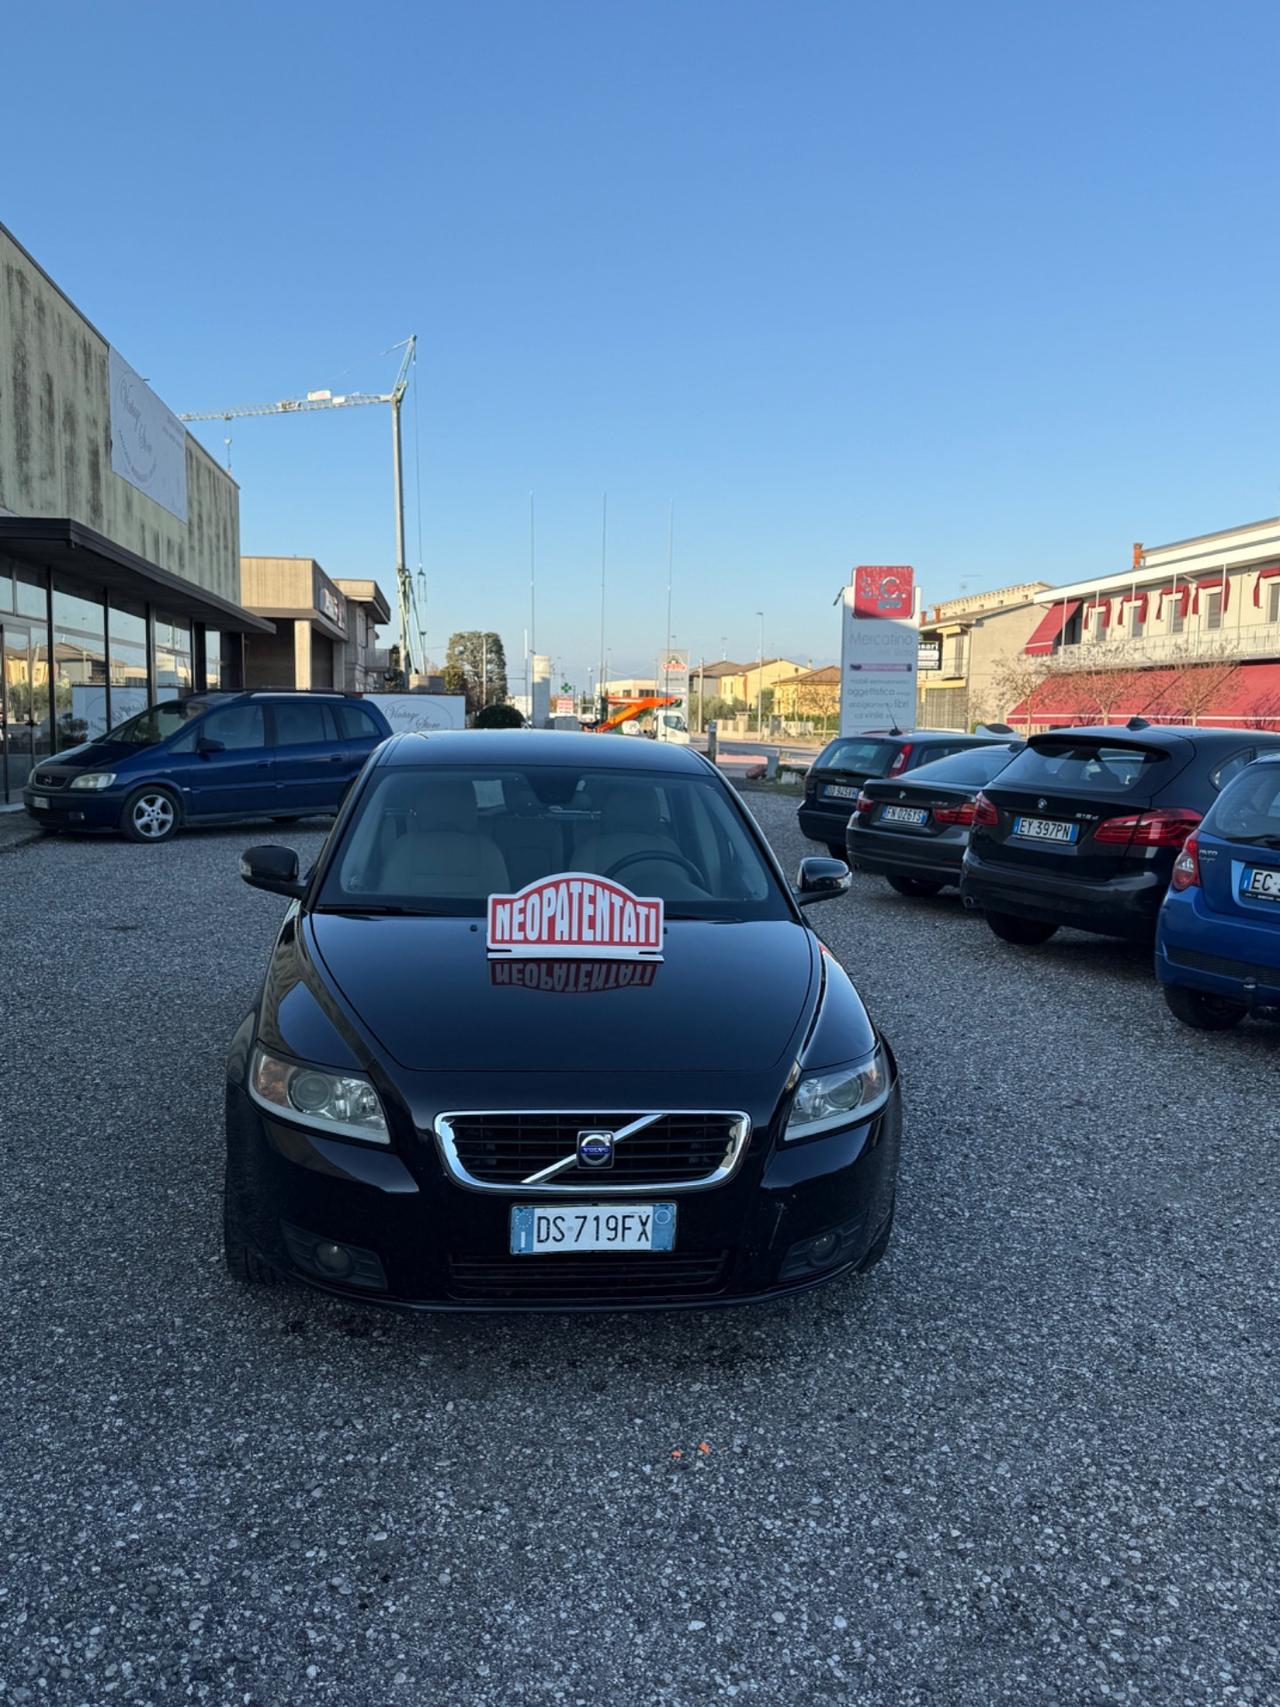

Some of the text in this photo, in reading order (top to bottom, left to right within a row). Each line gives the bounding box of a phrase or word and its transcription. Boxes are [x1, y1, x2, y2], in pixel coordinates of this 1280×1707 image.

[850, 632, 913, 646] Mercatino
[1019, 820, 1034, 833] EY
[1035, 821, 1071, 840] 397PN
[1251, 872, 1273, 891] EC
[495, 881, 657, 943] NEOPATENTATI
[536, 1215, 566, 1243] DS
[574, 1214, 651, 1243] 719FX
